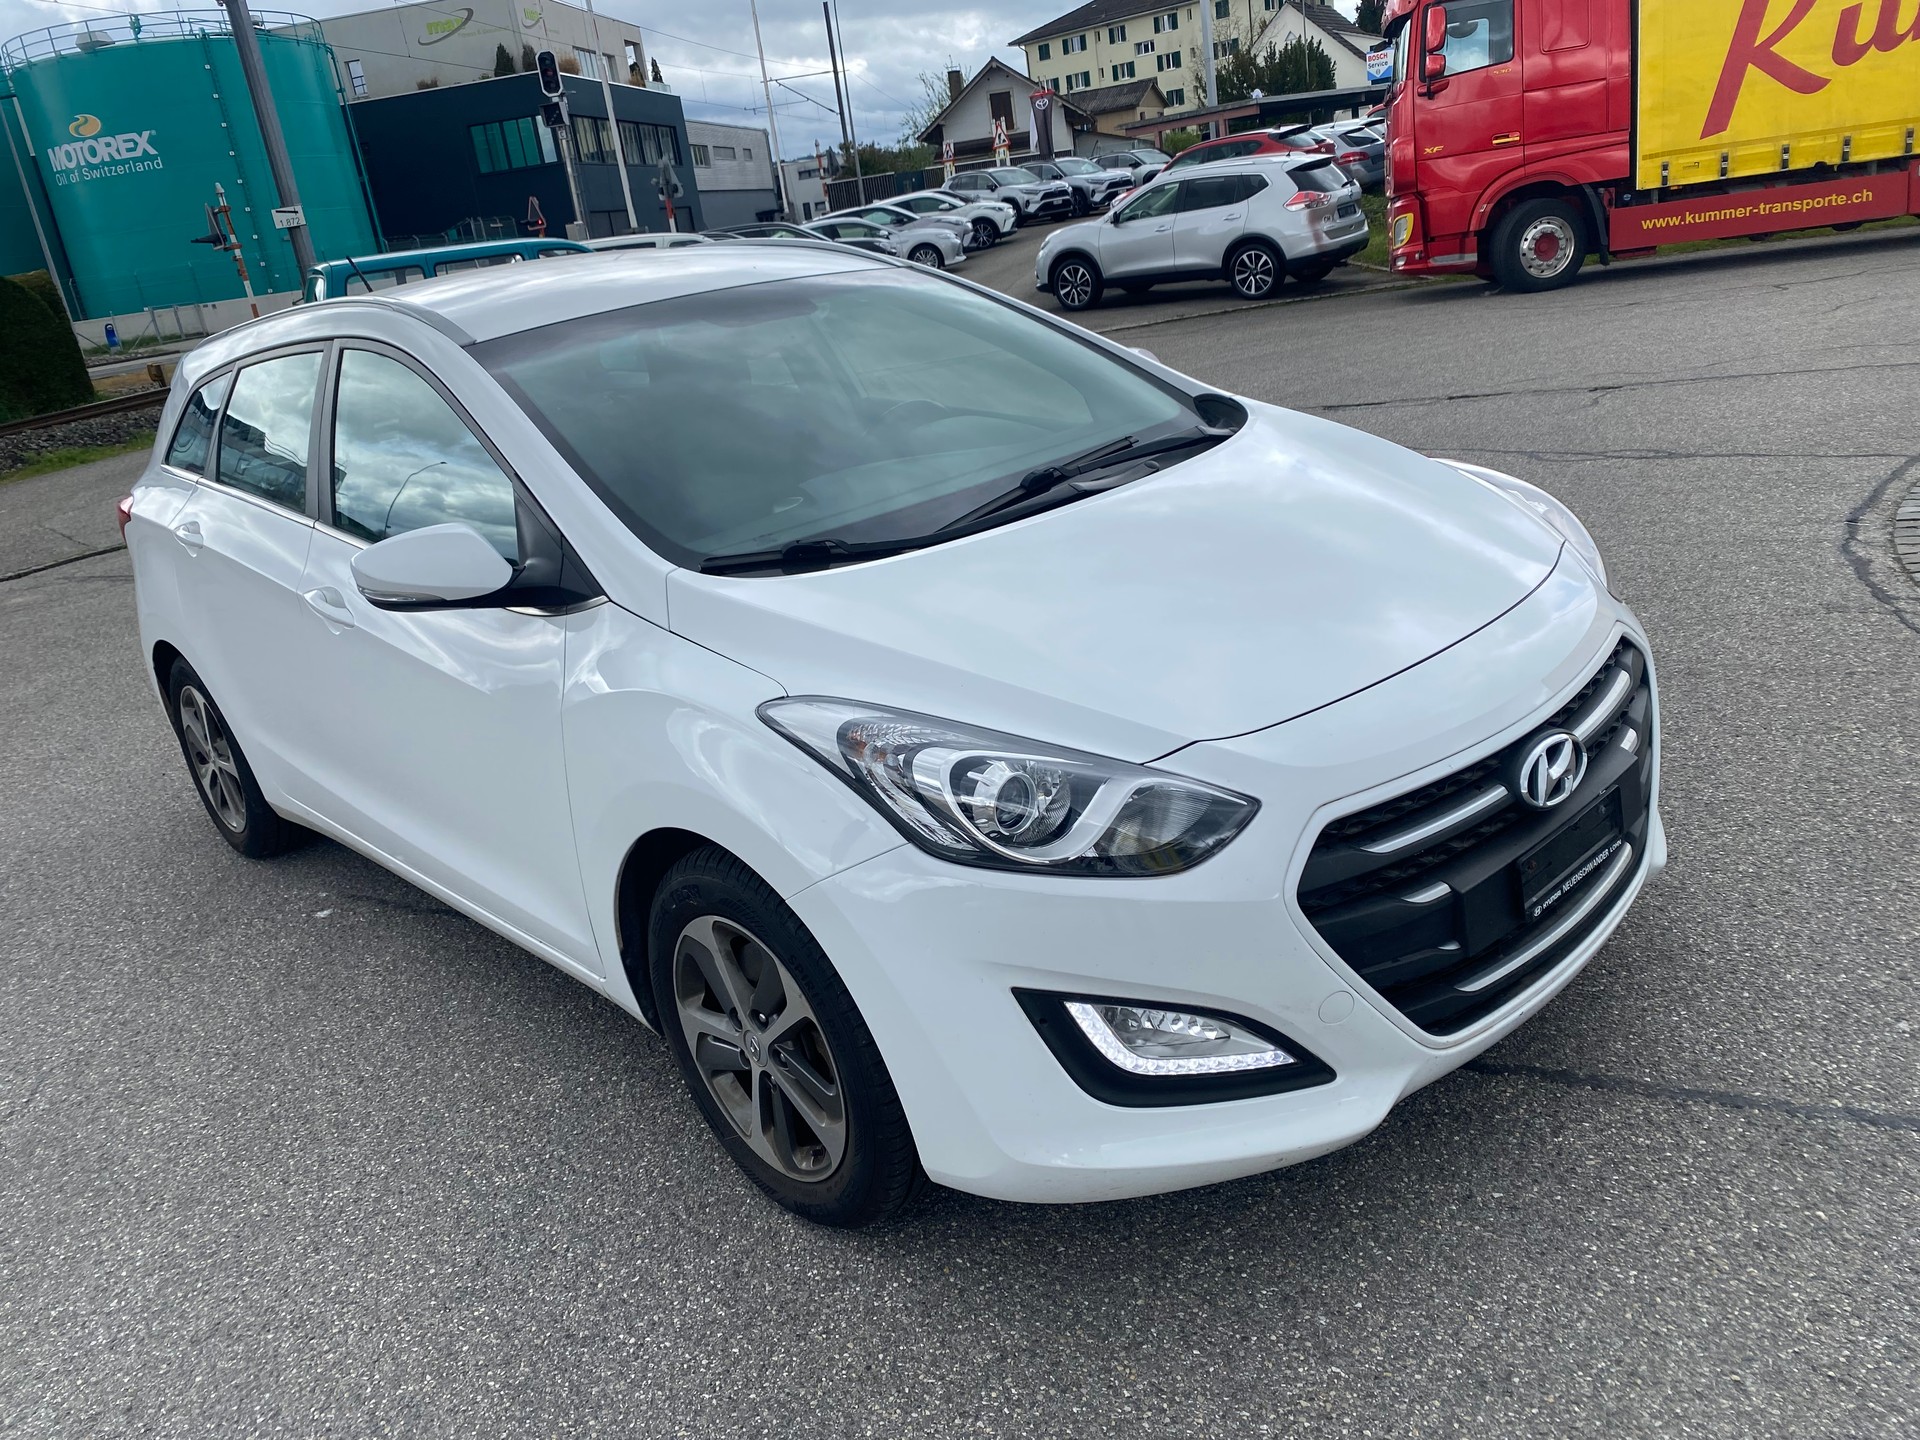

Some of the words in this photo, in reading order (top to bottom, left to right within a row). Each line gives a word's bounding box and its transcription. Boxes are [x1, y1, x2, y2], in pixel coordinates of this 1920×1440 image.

[1368, 52, 1388, 62] BOSCH
[1368, 61, 1388, 69] Service
[1700, 0, 1920, 140] Ku
[47, 131, 158, 172] MOTOREX
[1424, 145, 1444, 154] XF
[56, 173, 67, 186] Oil
[70, 170, 80, 183] of
[82, 157, 163, 180] Switzerland
[280, 217, 301, 227] 1.872
[1642, 189, 1873, 230] www.kummer-transporte.ch
[1563, 849, 1609, 892] NEUENSCHWANDER
